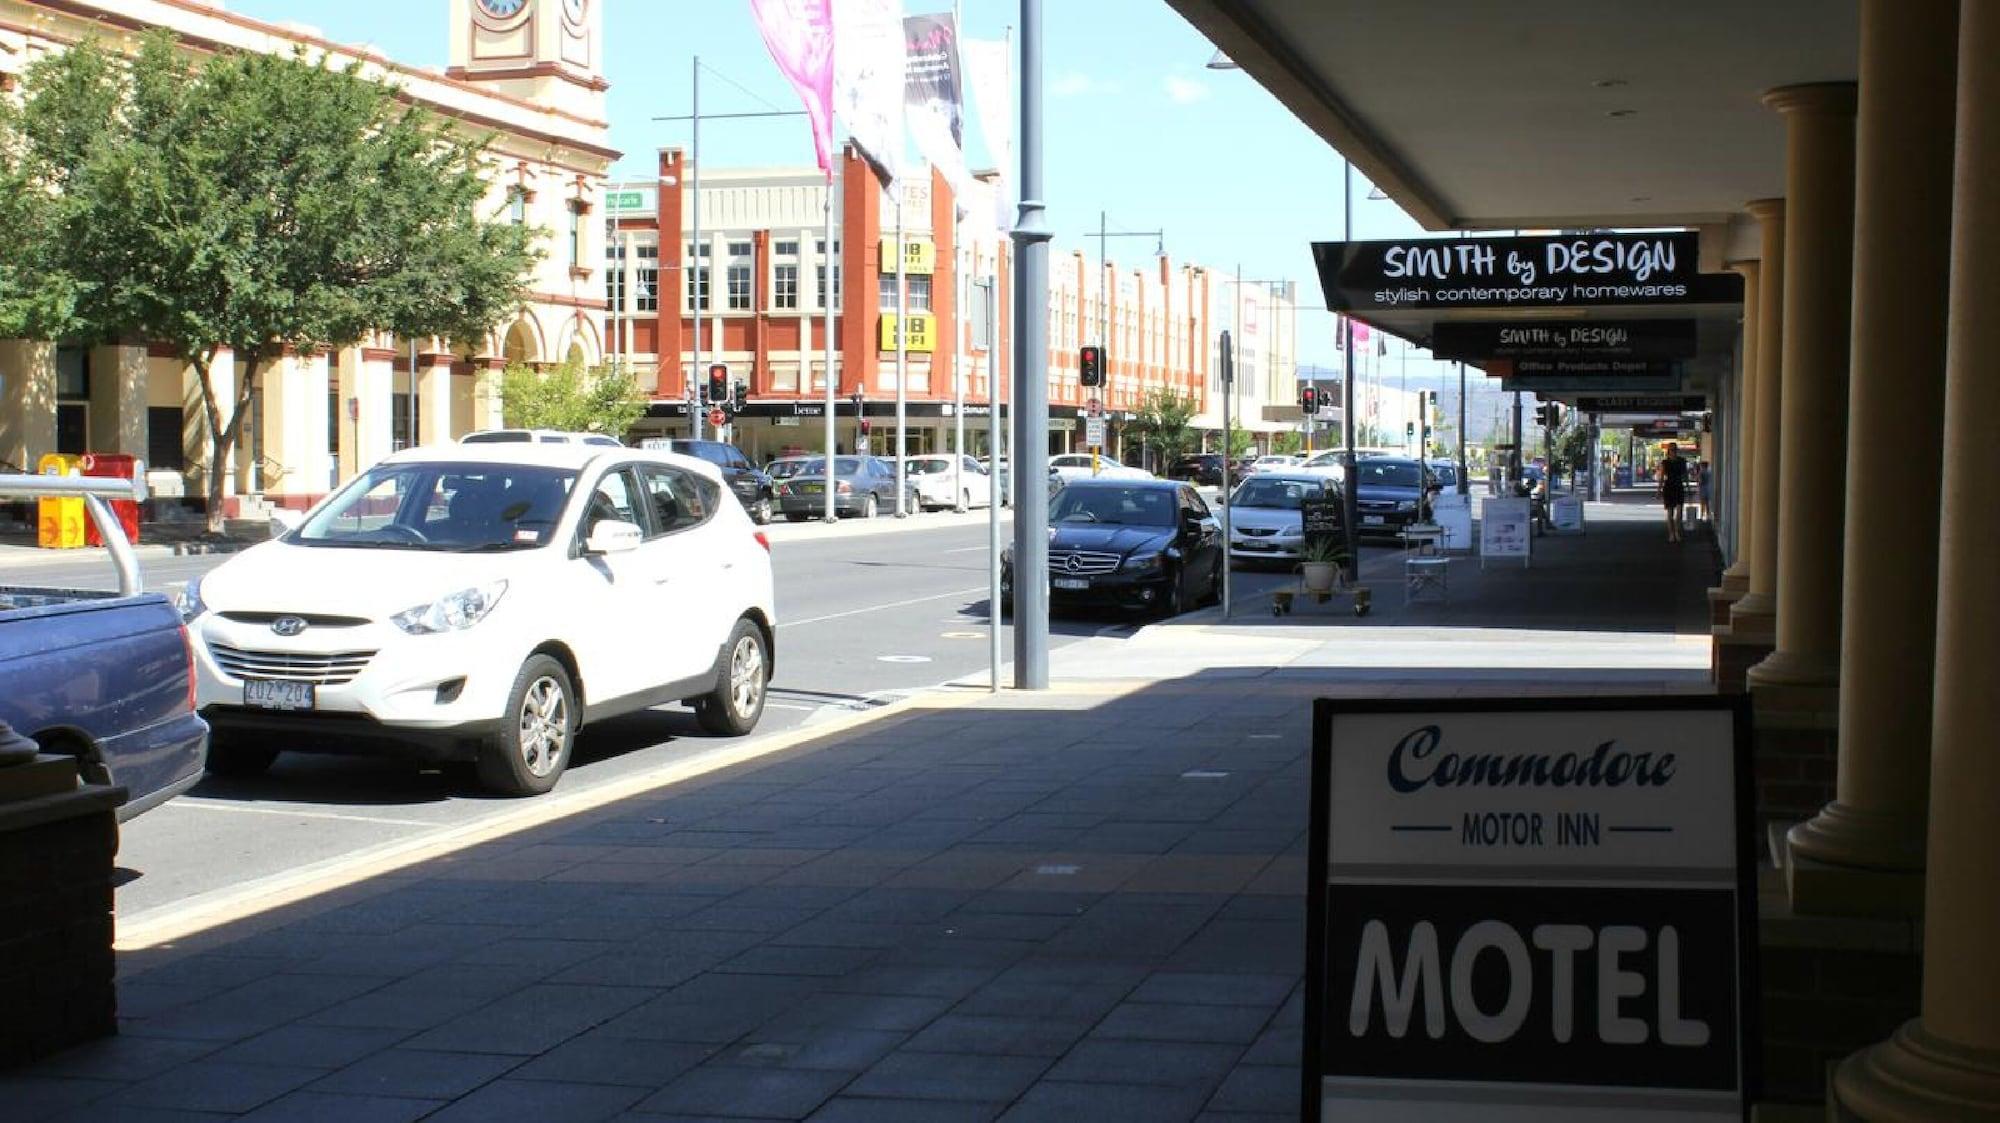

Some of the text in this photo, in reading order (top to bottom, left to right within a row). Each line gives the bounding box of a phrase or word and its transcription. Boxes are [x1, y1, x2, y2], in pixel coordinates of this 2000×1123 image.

[1383, 240, 1677, 285] SMITH by DESIGN
[1374, 282, 1688, 306] stylish contemporary homewares
[1500, 327, 1628, 347] SMITH by DESIGN
[1519, 361, 1648, 373] Office Products Depot
[1387, 725, 1677, 793] Commodore
[1462, 812, 1600, 846] MOTOR INN
[1349, 919, 1711, 1046] MOTEL
